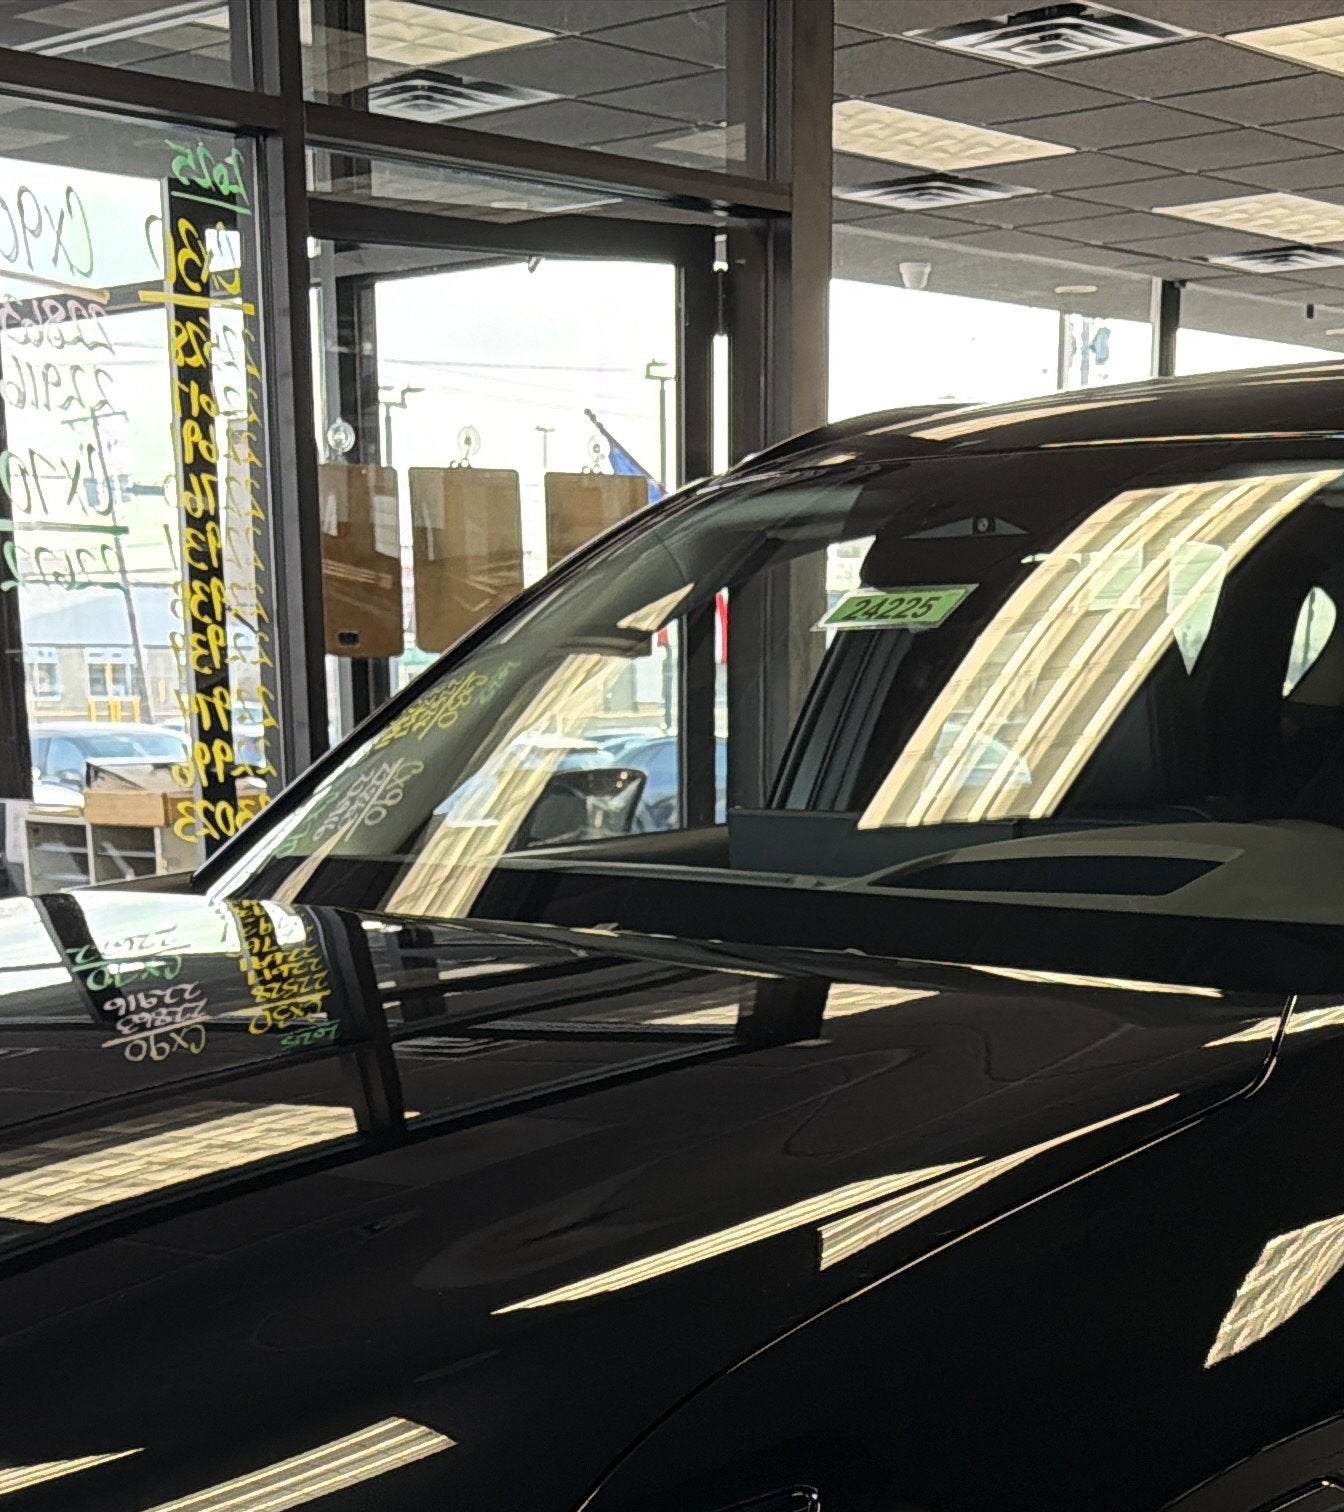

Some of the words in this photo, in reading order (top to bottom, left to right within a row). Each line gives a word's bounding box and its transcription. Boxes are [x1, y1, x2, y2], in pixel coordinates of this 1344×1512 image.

[842, 597, 940, 621] 24225
[104, 981, 201, 1013] 22916
[116, 998, 208, 1036] 22863
[124, 1024, 207, 1062] CX90
